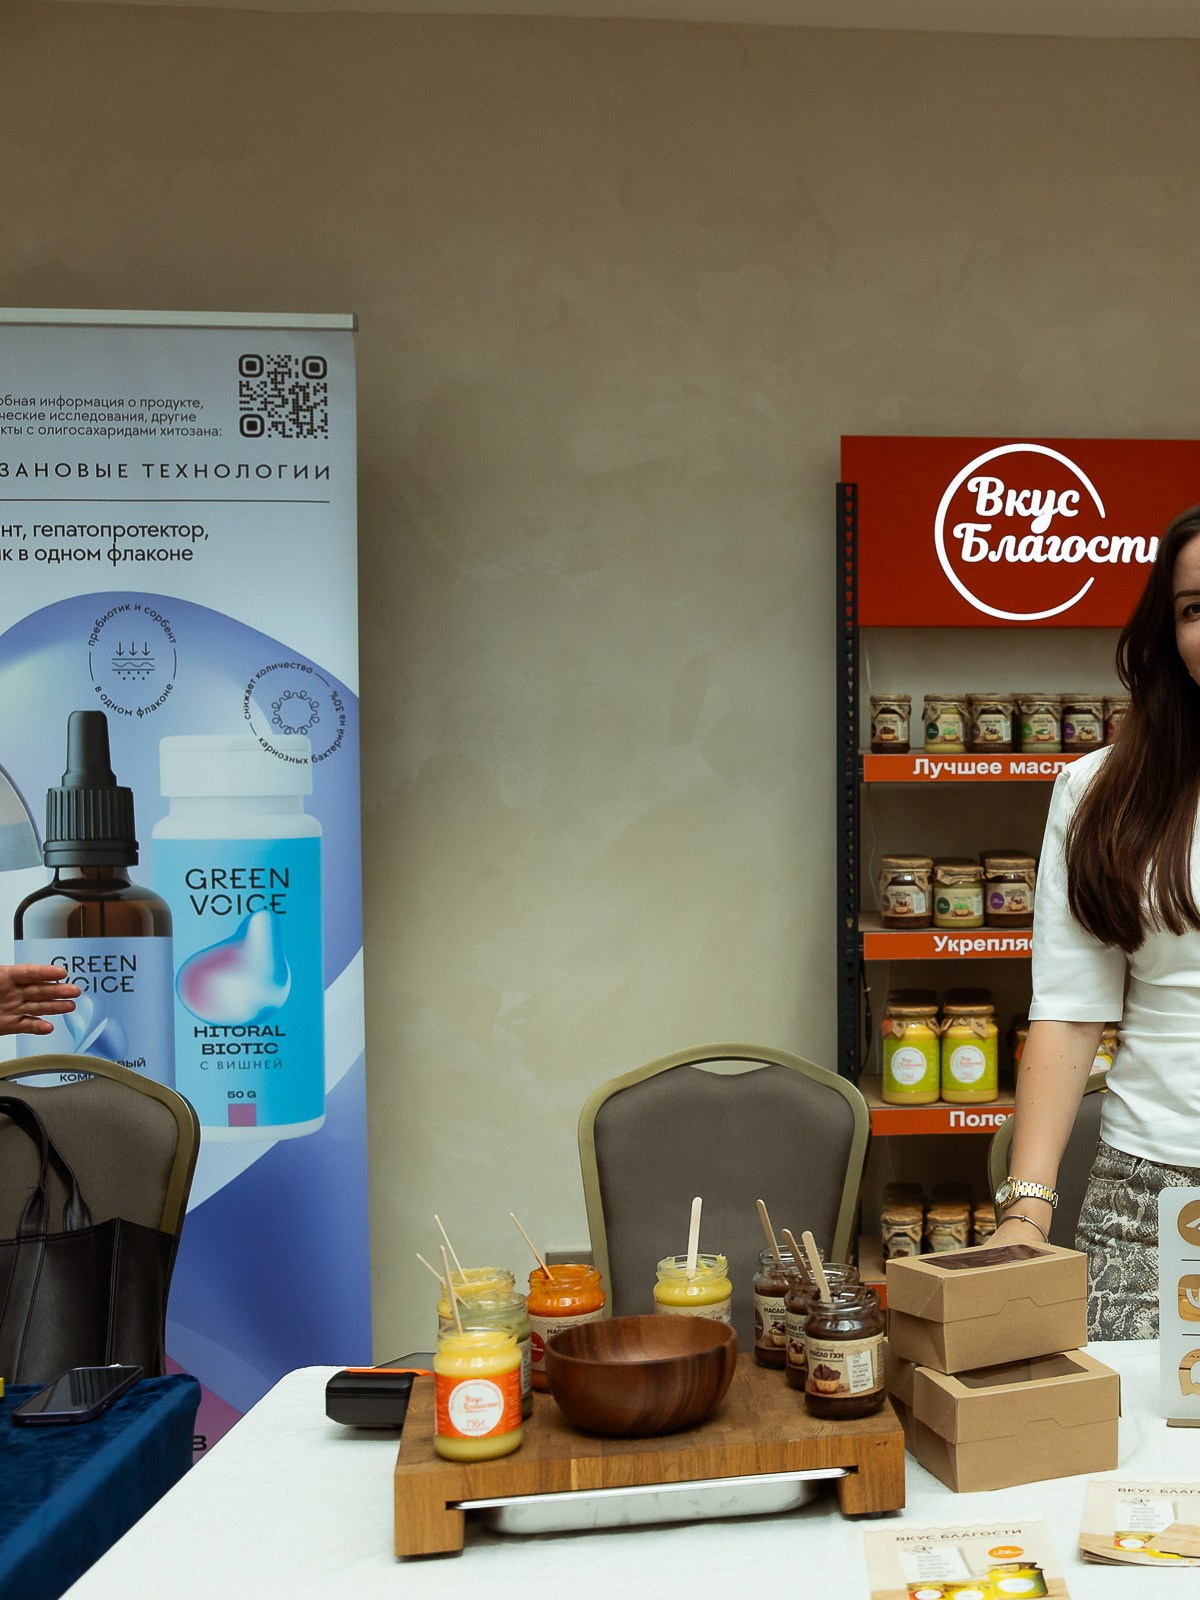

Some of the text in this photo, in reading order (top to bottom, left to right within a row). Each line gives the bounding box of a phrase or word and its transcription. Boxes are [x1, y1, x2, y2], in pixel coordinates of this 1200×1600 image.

[40, 394, 124, 410] информация
[128, 399, 137, 408] о
[140, 398, 204, 411] продукте,
[49, 411, 148, 425] исследования,
[151, 412, 197, 425] другие
[26, 426, 34, 435] с
[38, 426, 157, 439] олигосахаридами
[160, 427, 223, 438] хитозана:
[0, 462, 331, 480] ЗАНОВЫЕ ТЕХНОЛОГИИ
[966, 476, 1081, 535] Вкус
[33, 524, 210, 543] гепатопротектор,
[0, 543, 194, 567] к в одном флаконе
[88, 603, 177, 647] пребиотик и сорбент
[243, 661, 314, 720] снижает количество
[94, 683, 174, 719] в одном флаконе
[258, 690, 346, 764] кариозных бактерий на 30%
[912, 758, 1067, 779] Лучшее масл
[185, 867, 290, 891] GREEN
[189, 893, 288, 916] VOICE
[50, 954, 137, 974] GREEN
[193, 1026, 287, 1039] HITORAL
[201, 1043, 279, 1056] BIOTIC
[112, 1057, 146, 1068] ВЫЙ
[200, 1058, 284, 1071] С ВИШНЕЙ
[60, 1073, 96, 1082] КОМП
[227, 1091, 245, 1099] 50
[949, 1110, 1012, 1128] Поле
[763, 1306, 786, 1314] МАСЛО
[809, 1350, 829, 1358] МАСЛО
[829, 1352, 844, 1360] ГХИ
[1117, 1487, 1153, 1495] ВКУС
[896, 1529, 1022, 1542] ВКУС БЛАГОСТИ
